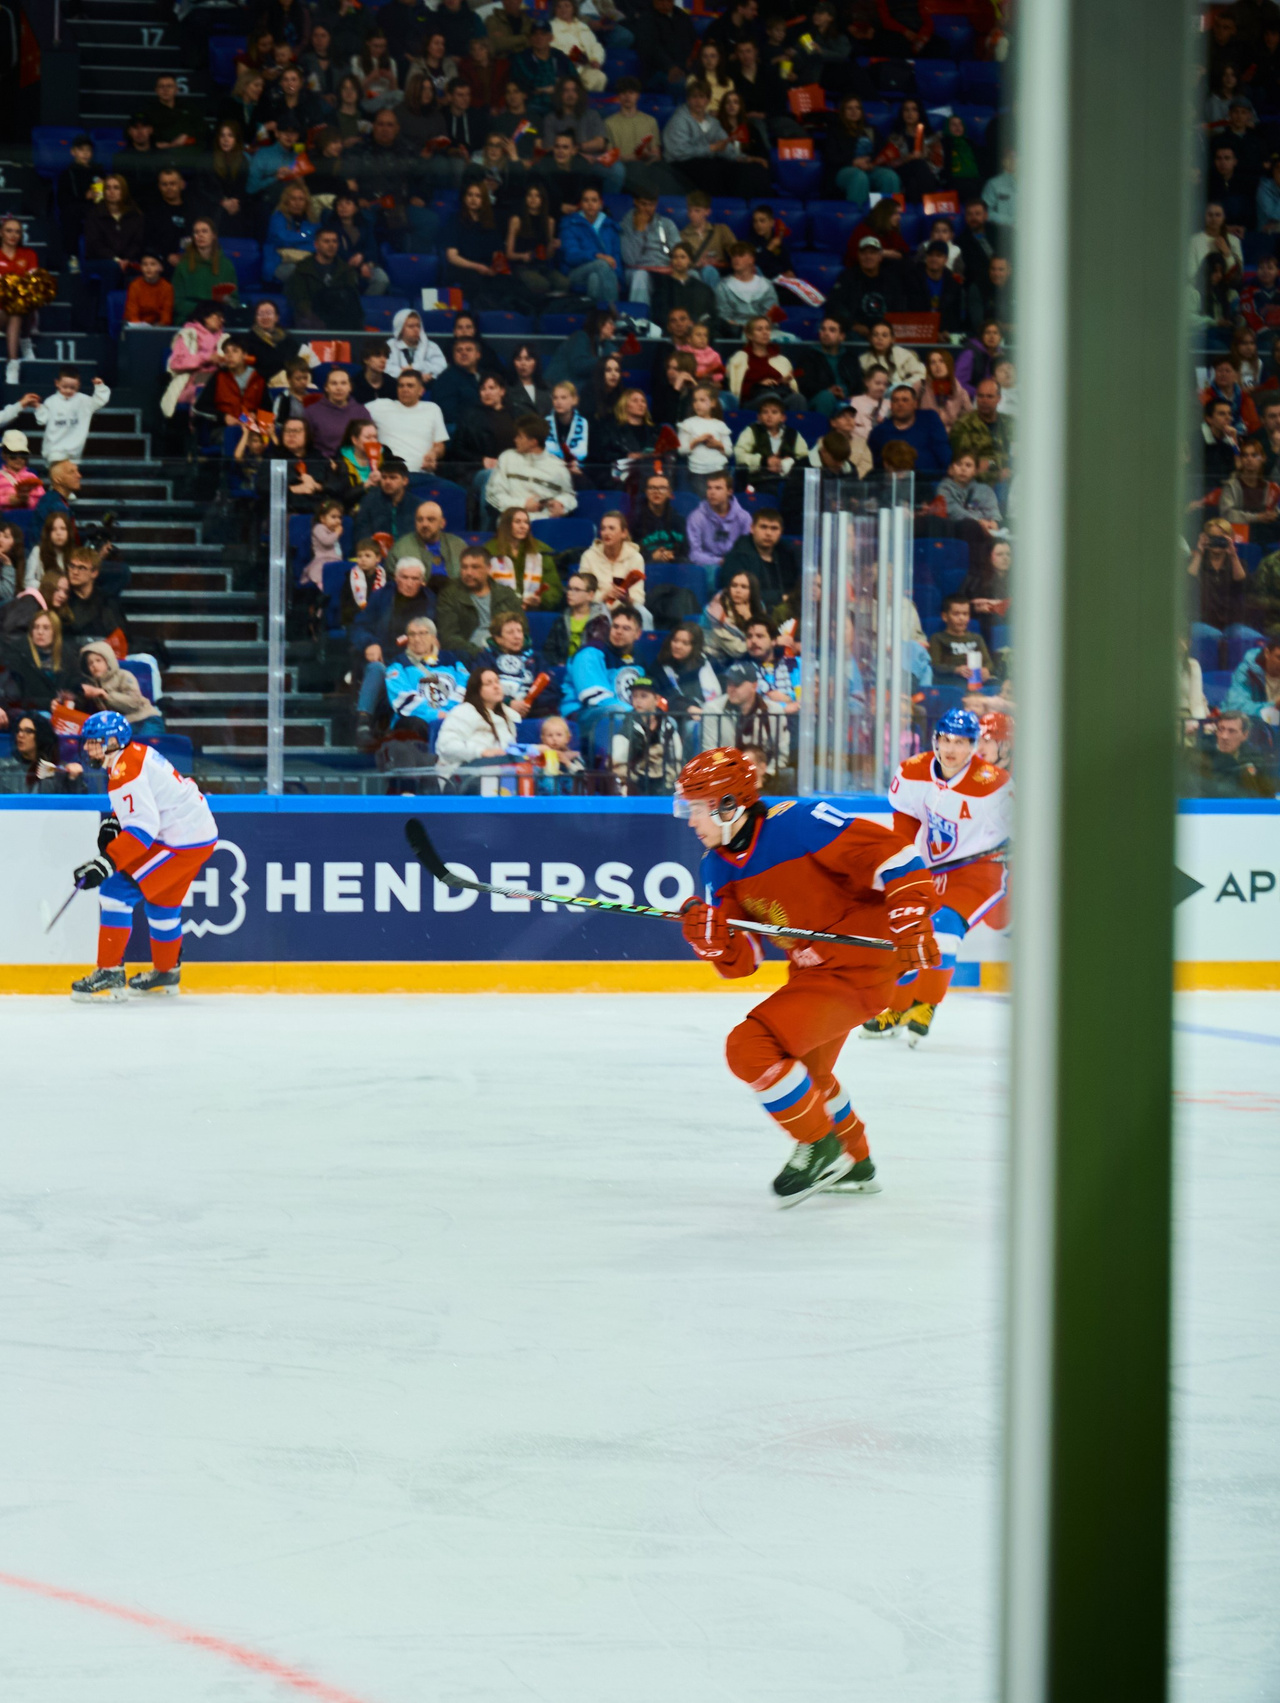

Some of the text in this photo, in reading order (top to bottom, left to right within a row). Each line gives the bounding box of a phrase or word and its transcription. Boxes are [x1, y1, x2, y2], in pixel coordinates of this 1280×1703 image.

[140, 27, 165, 48] 17
[54, 339, 76, 362] 11
[122, 794, 135, 813] 7
[958, 800, 973, 820] A
[265, 861, 695, 913] HENDERSO
